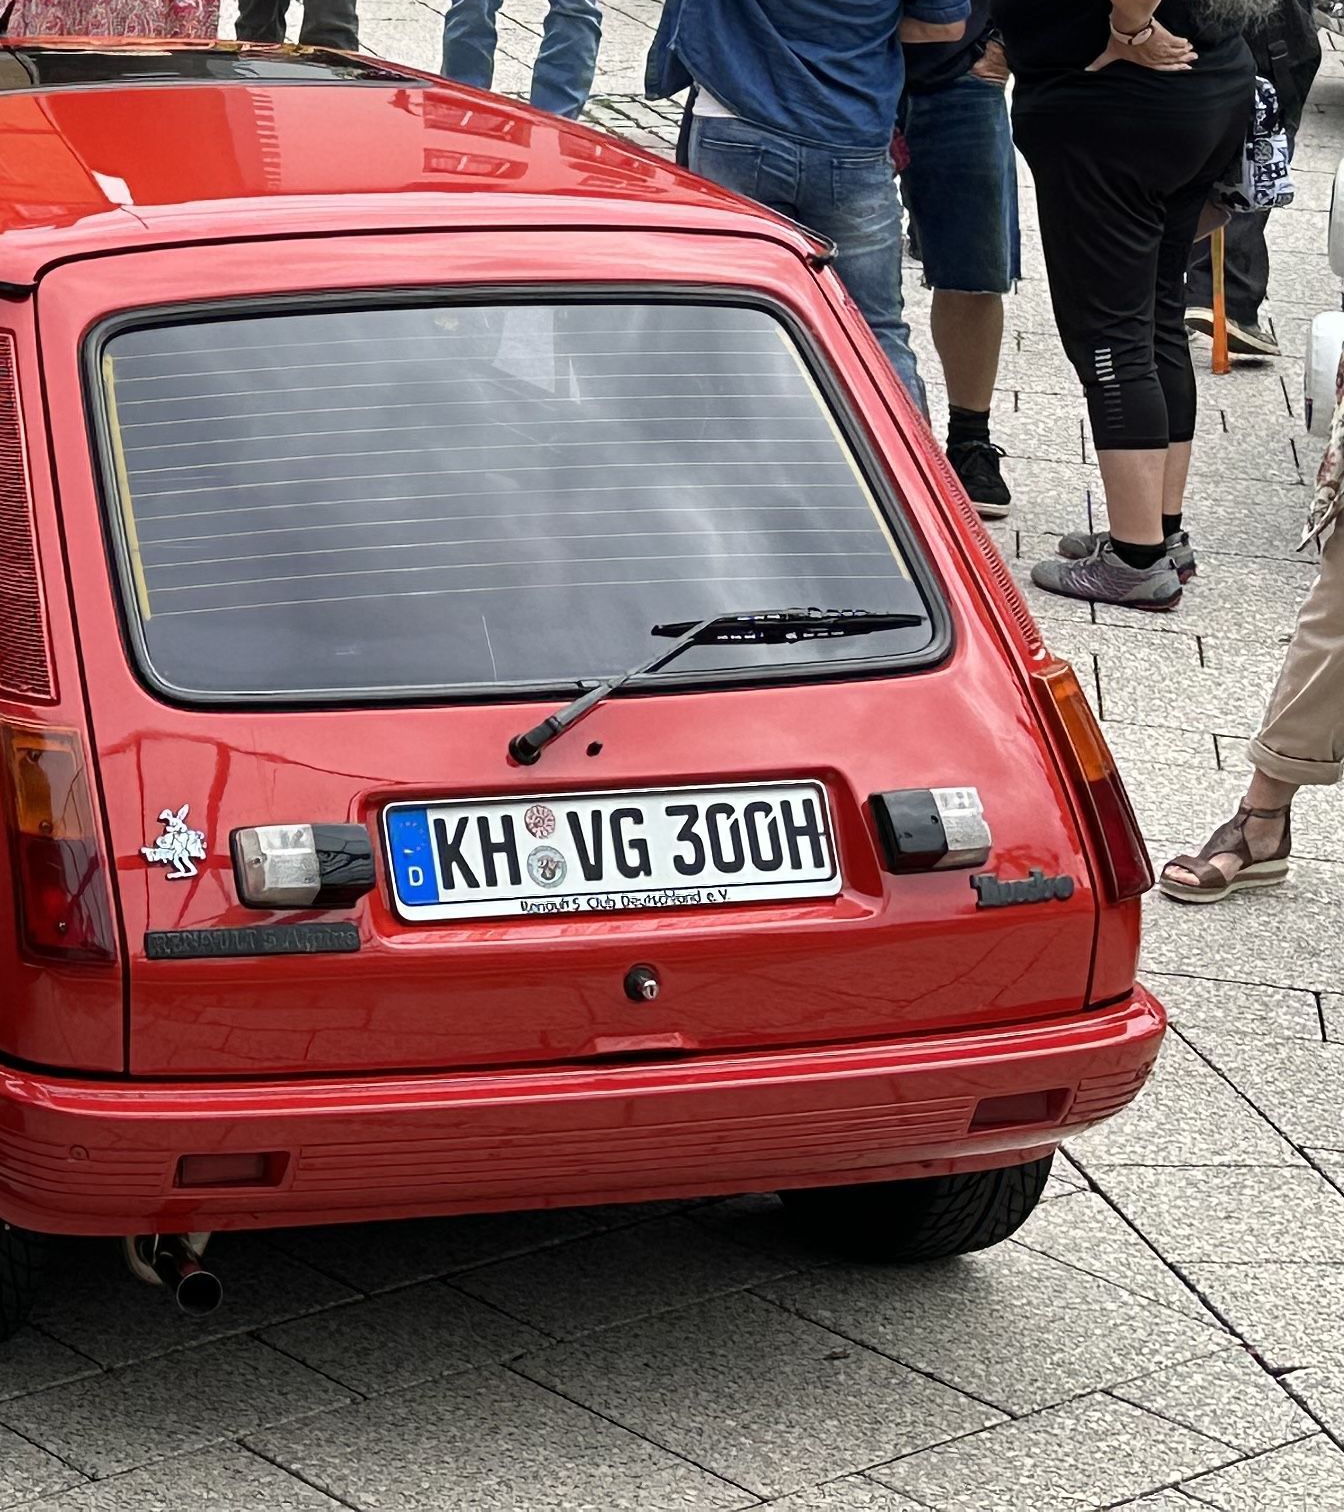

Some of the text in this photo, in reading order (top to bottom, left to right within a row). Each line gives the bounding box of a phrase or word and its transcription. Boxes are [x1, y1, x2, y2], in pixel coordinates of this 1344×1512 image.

[407, 797, 828, 890] D KH VG 300H
